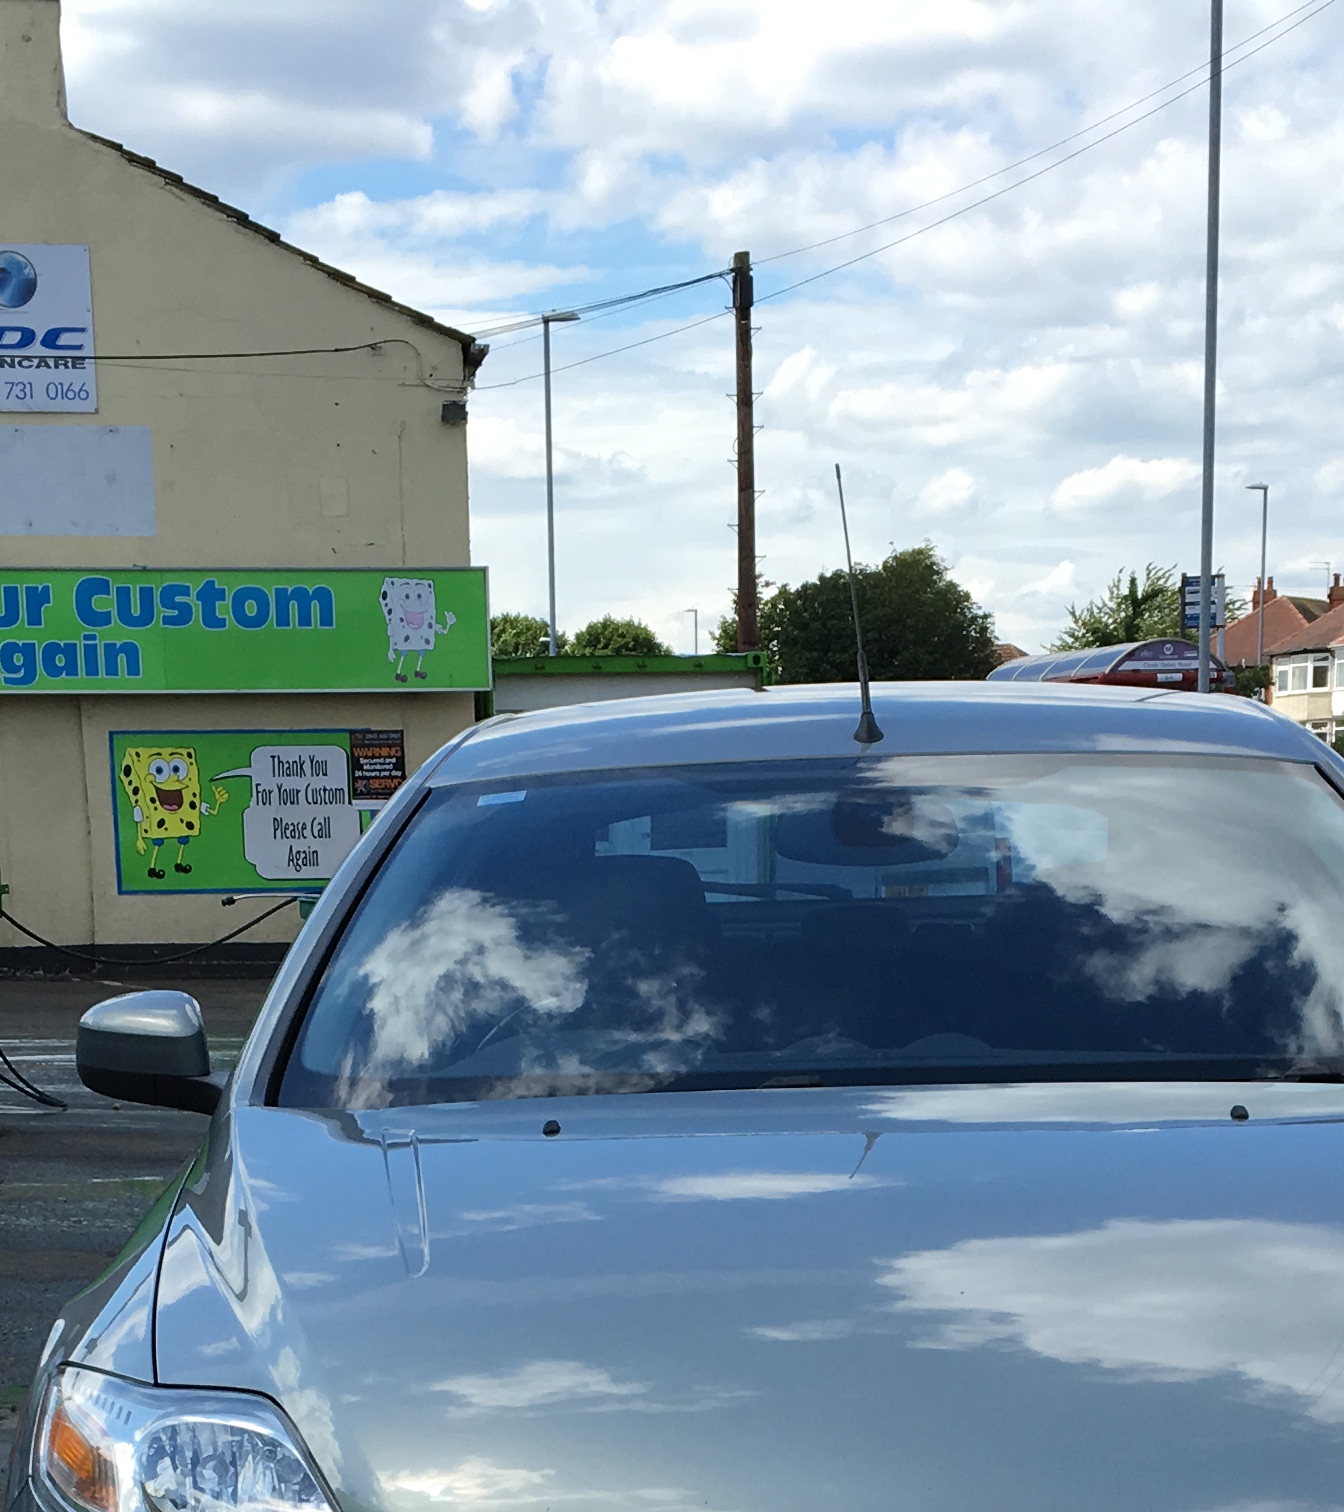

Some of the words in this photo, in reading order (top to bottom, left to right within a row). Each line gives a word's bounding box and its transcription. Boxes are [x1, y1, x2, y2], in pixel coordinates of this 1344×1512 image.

[4, 381, 34, 400] 731
[46, 381, 90, 401] 0166
[74, 576, 336, 630] Custom
[352, 747, 402, 757] WARNING
[270, 754, 306, 777] Thank
[309, 754, 328, 777] You
[256, 785, 272, 807] For
[275, 785, 301, 807] Your
[305, 784, 346, 806] Custom
[273, 817, 307, 840] Please
[310, 816, 331, 840] Call
[287, 846, 319, 872] Again
